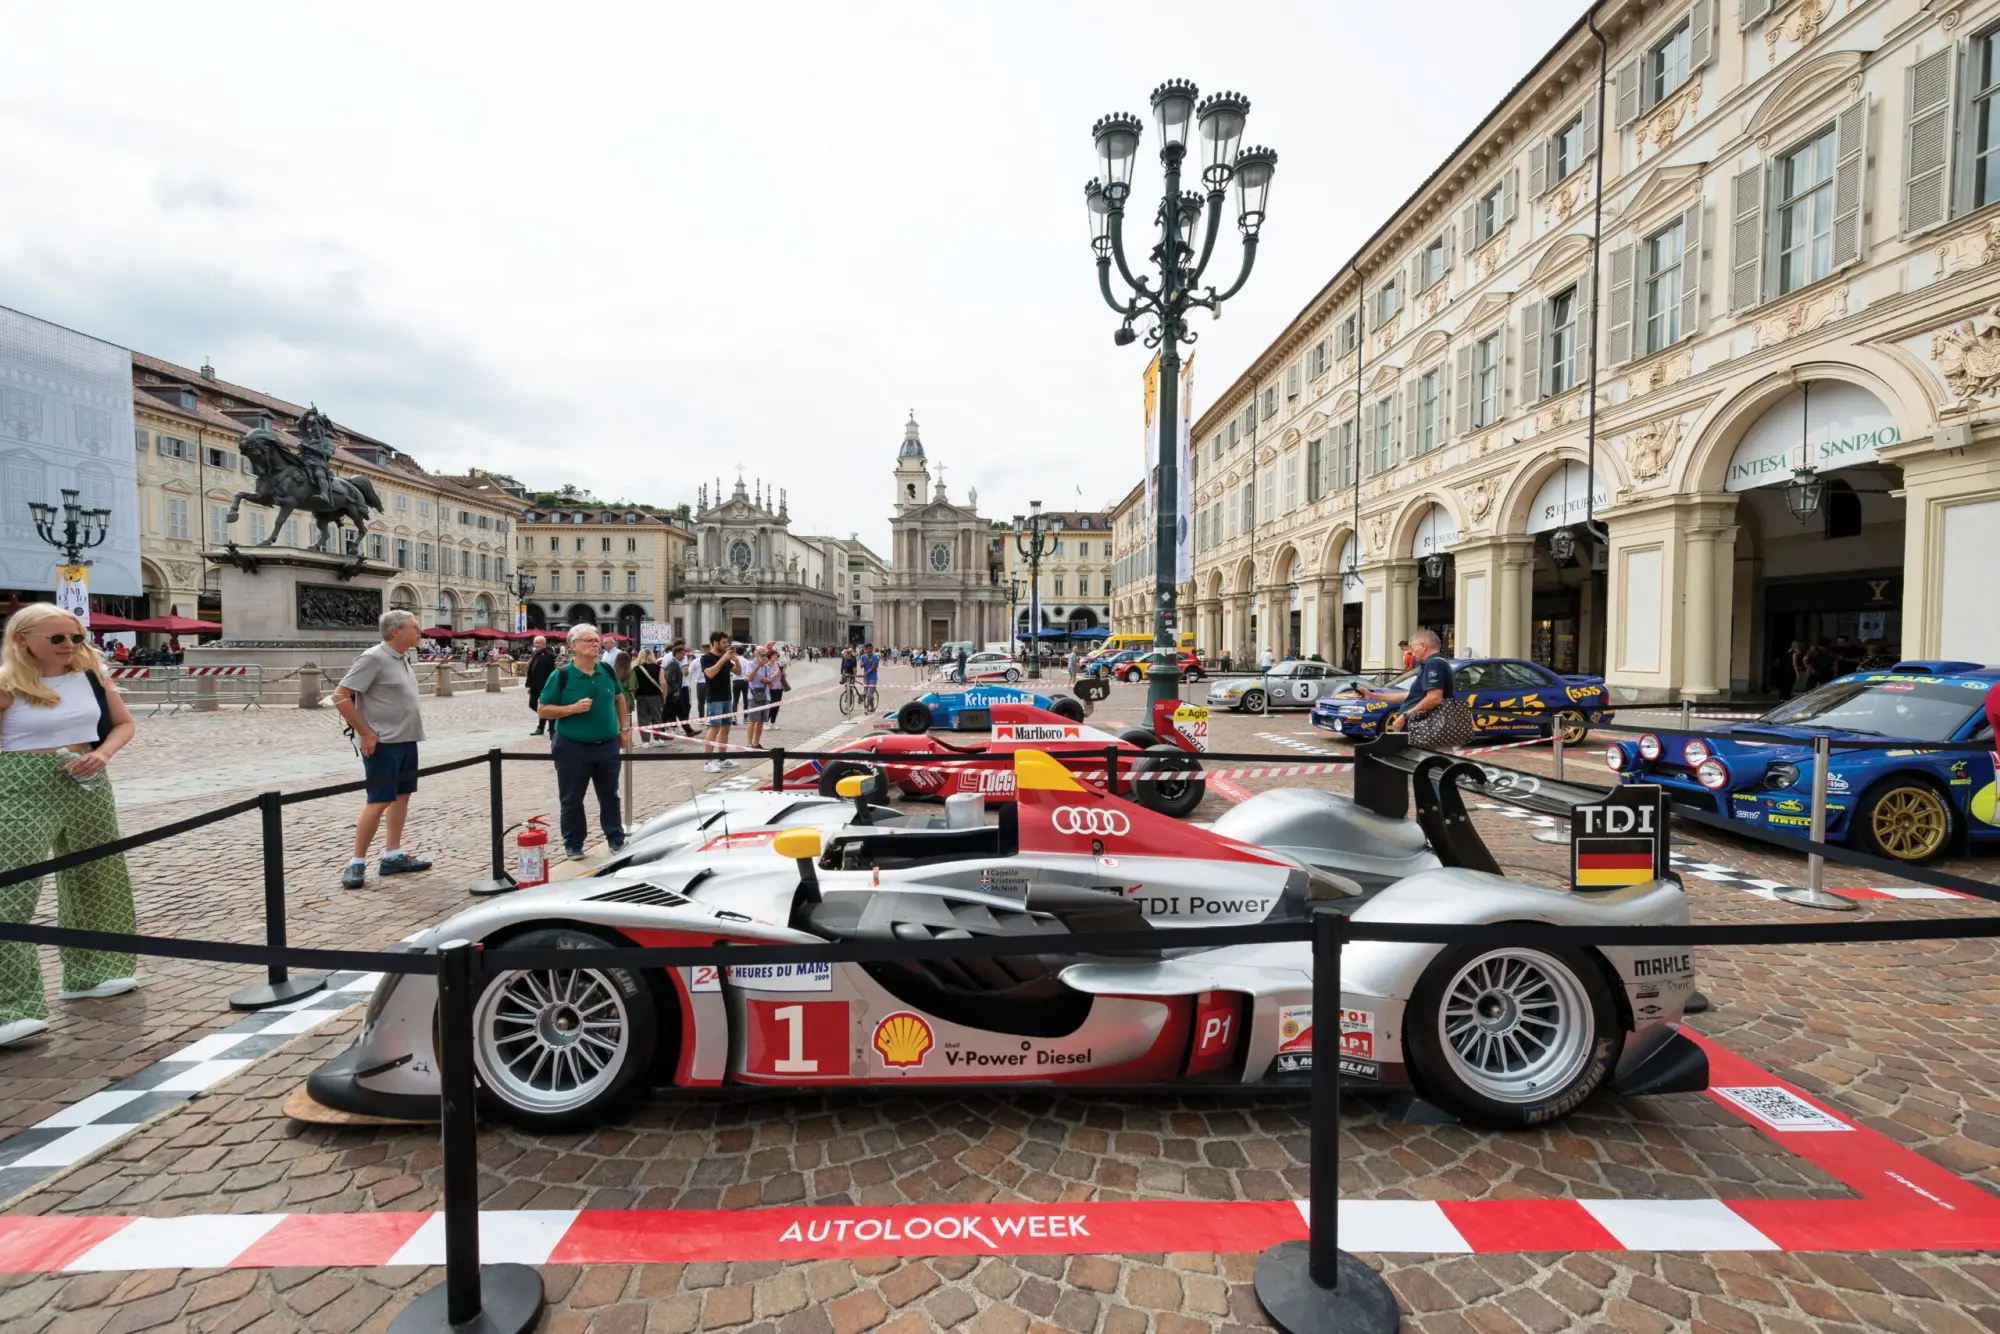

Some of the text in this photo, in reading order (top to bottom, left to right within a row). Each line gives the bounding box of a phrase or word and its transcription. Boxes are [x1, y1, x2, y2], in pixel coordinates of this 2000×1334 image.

[1732, 454, 1787, 480] INTESA
[1866, 675, 1944, 684] SUBARU
[1089, 687, 1104, 699] 21
[1300, 683, 1309, 698] 3
[1188, 708, 1208, 719] Agip
[1015, 726, 1063, 740] Marlboro
[1193, 721, 1207, 737] 22
[1177, 725, 1206, 753] CAMOZZI
[1732, 793, 1758, 802] MOTUL
[1576, 806, 1654, 833] TDI
[1769, 813, 1812, 826] PIRELL
[991, 869, 1019, 877] Capello
[991, 884, 1018, 892] McNish
[1134, 897, 1270, 915] TDI Power
[735, 966, 773, 979] HEURES
[776, 965, 792, 977] DU
[796, 961, 830, 976] MANS
[1634, 954, 1690, 977] MAHLE
[814, 974, 830, 982] 2009
[1347, 1011, 1368, 1024] 01
[775, 1005, 818, 1072] 1
[1202, 1014, 1232, 1049] P1
[945, 1048, 1092, 1066] V-Power Diesel
[1300, 1057, 1376, 1076] MELIN
[1527, 1061, 1606, 1122] MICHELIN
[778, 1215, 1090, 1249] AUTOLOOK WEEK
